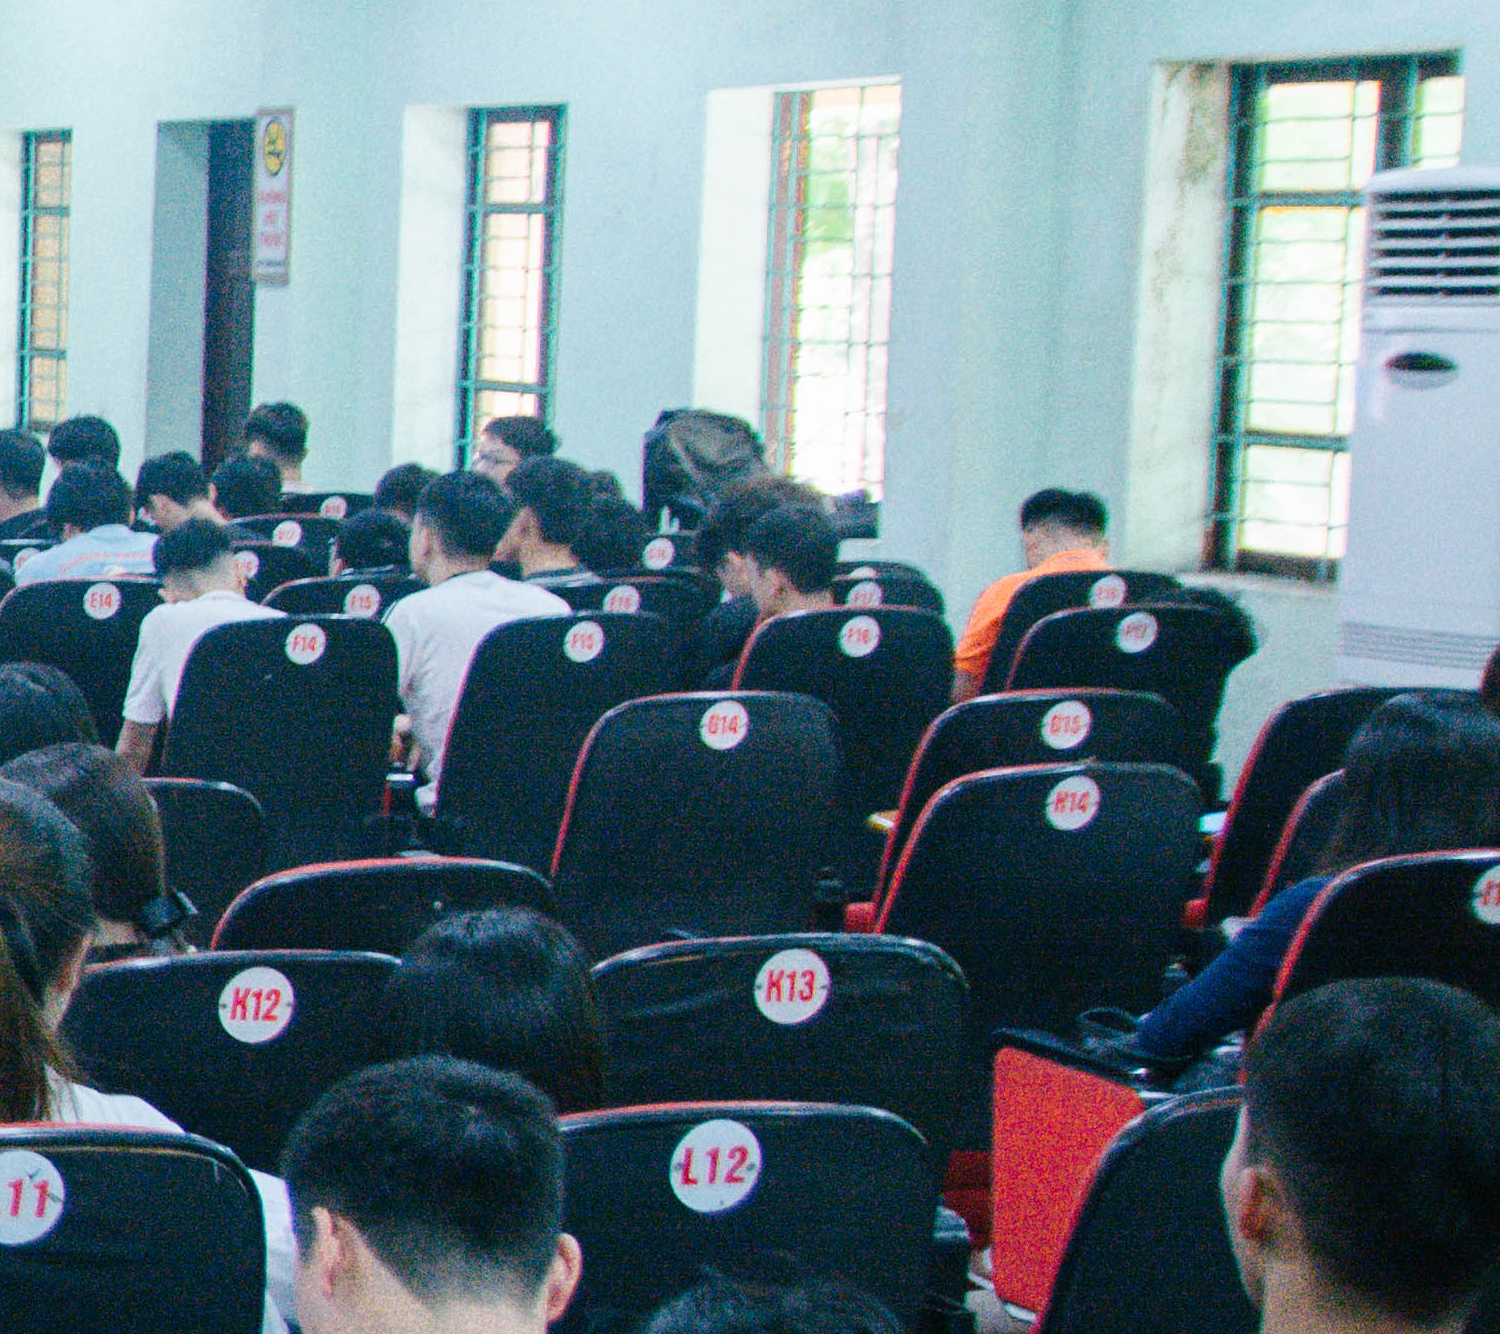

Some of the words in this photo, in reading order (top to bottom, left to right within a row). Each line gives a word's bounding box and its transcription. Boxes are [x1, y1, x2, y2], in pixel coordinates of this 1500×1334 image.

[766, 968, 816, 1003] K13
[232, 988, 282, 1023] K12
[681, 1146, 749, 1186] L12
